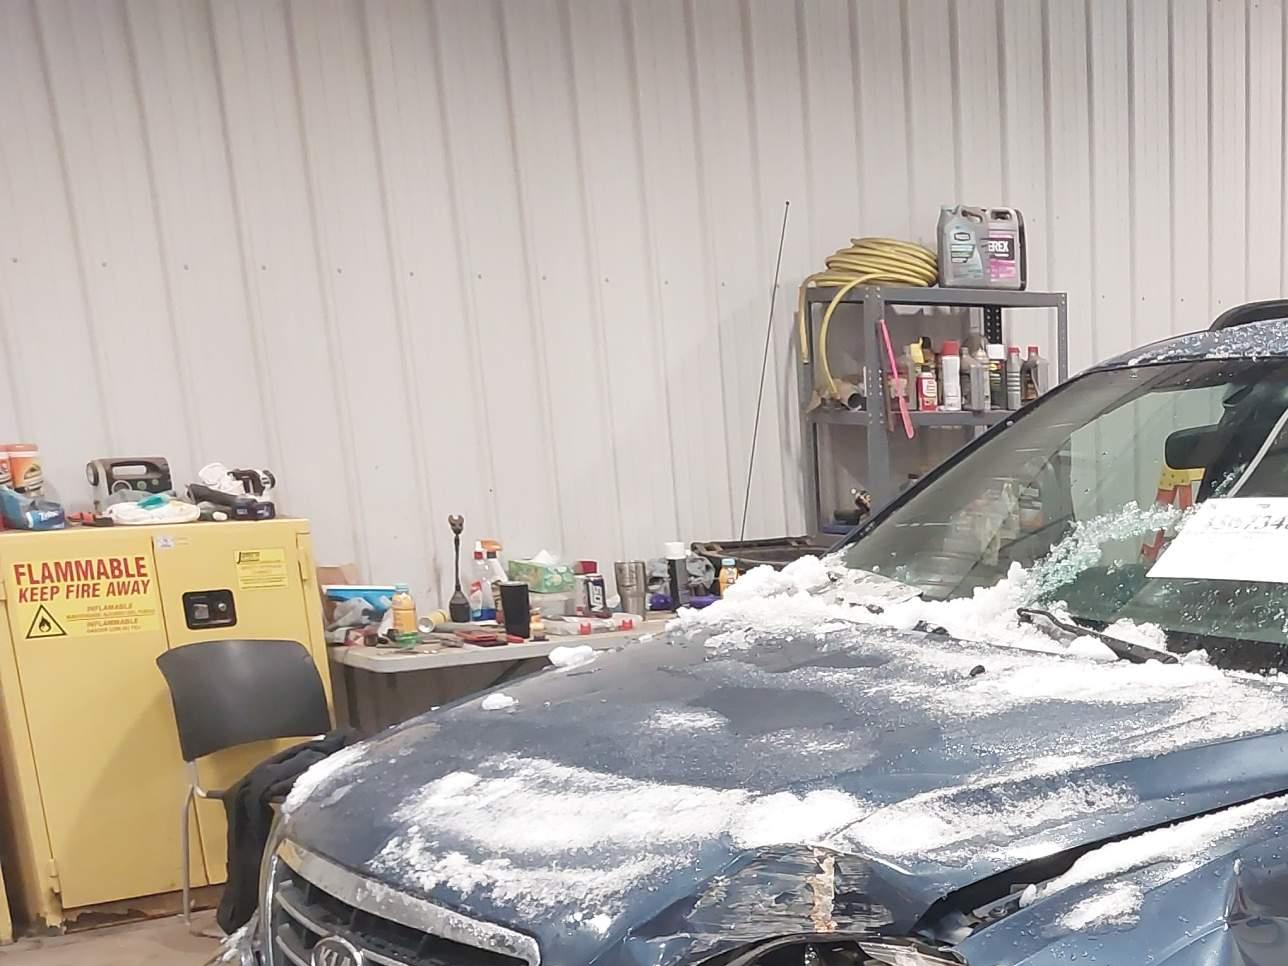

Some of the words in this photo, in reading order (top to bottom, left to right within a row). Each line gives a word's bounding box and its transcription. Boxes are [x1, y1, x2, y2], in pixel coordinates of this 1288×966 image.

[13, 556, 149, 586] FLAMMABLE
[18, 585, 60, 604] KEEP
[65, 583, 101, 600] FIRE
[105, 579, 151, 597] AWAY
[588, 581, 604, 613] NOS
